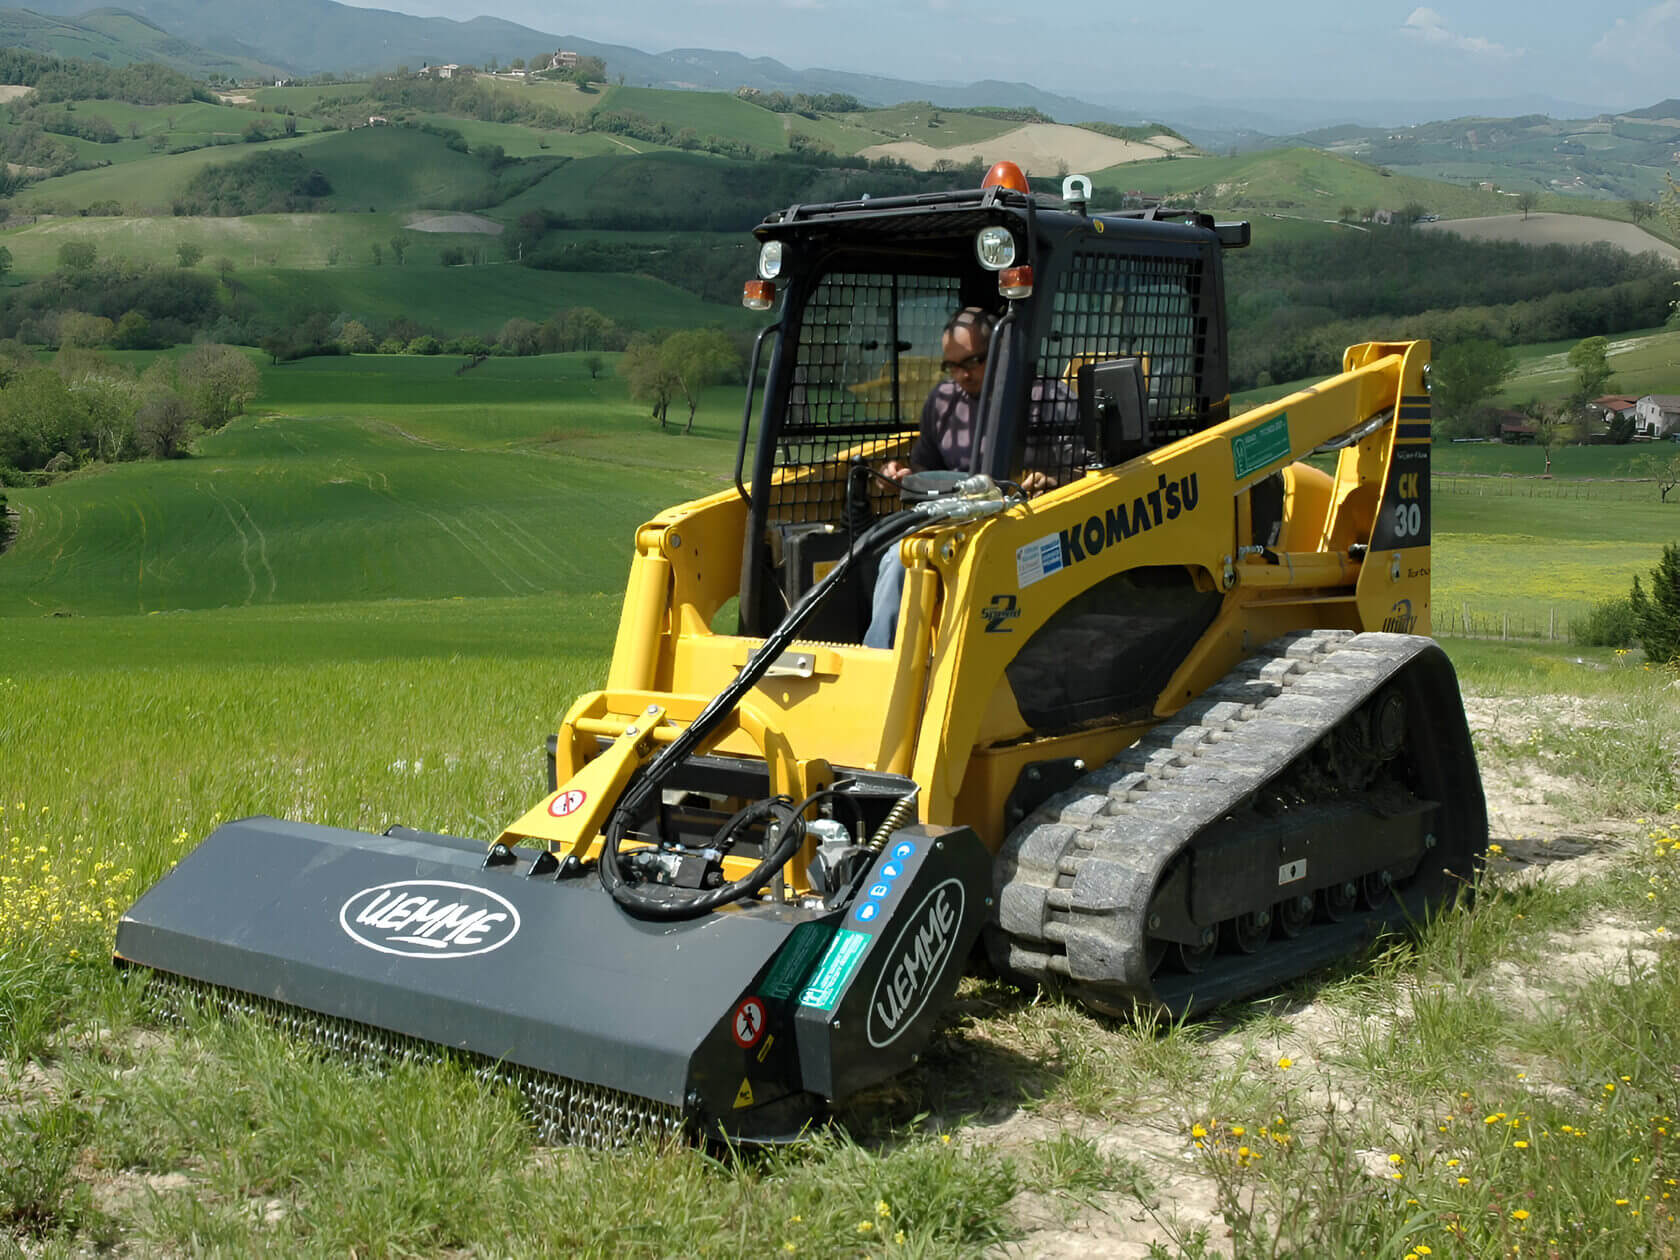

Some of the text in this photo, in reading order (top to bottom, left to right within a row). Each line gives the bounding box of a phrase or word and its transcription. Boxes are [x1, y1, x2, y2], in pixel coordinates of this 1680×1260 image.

[1398, 472, 1418, 498] CK
[1060, 472, 1199, 567] KOMATSU
[1394, 503, 1421, 537] 30
